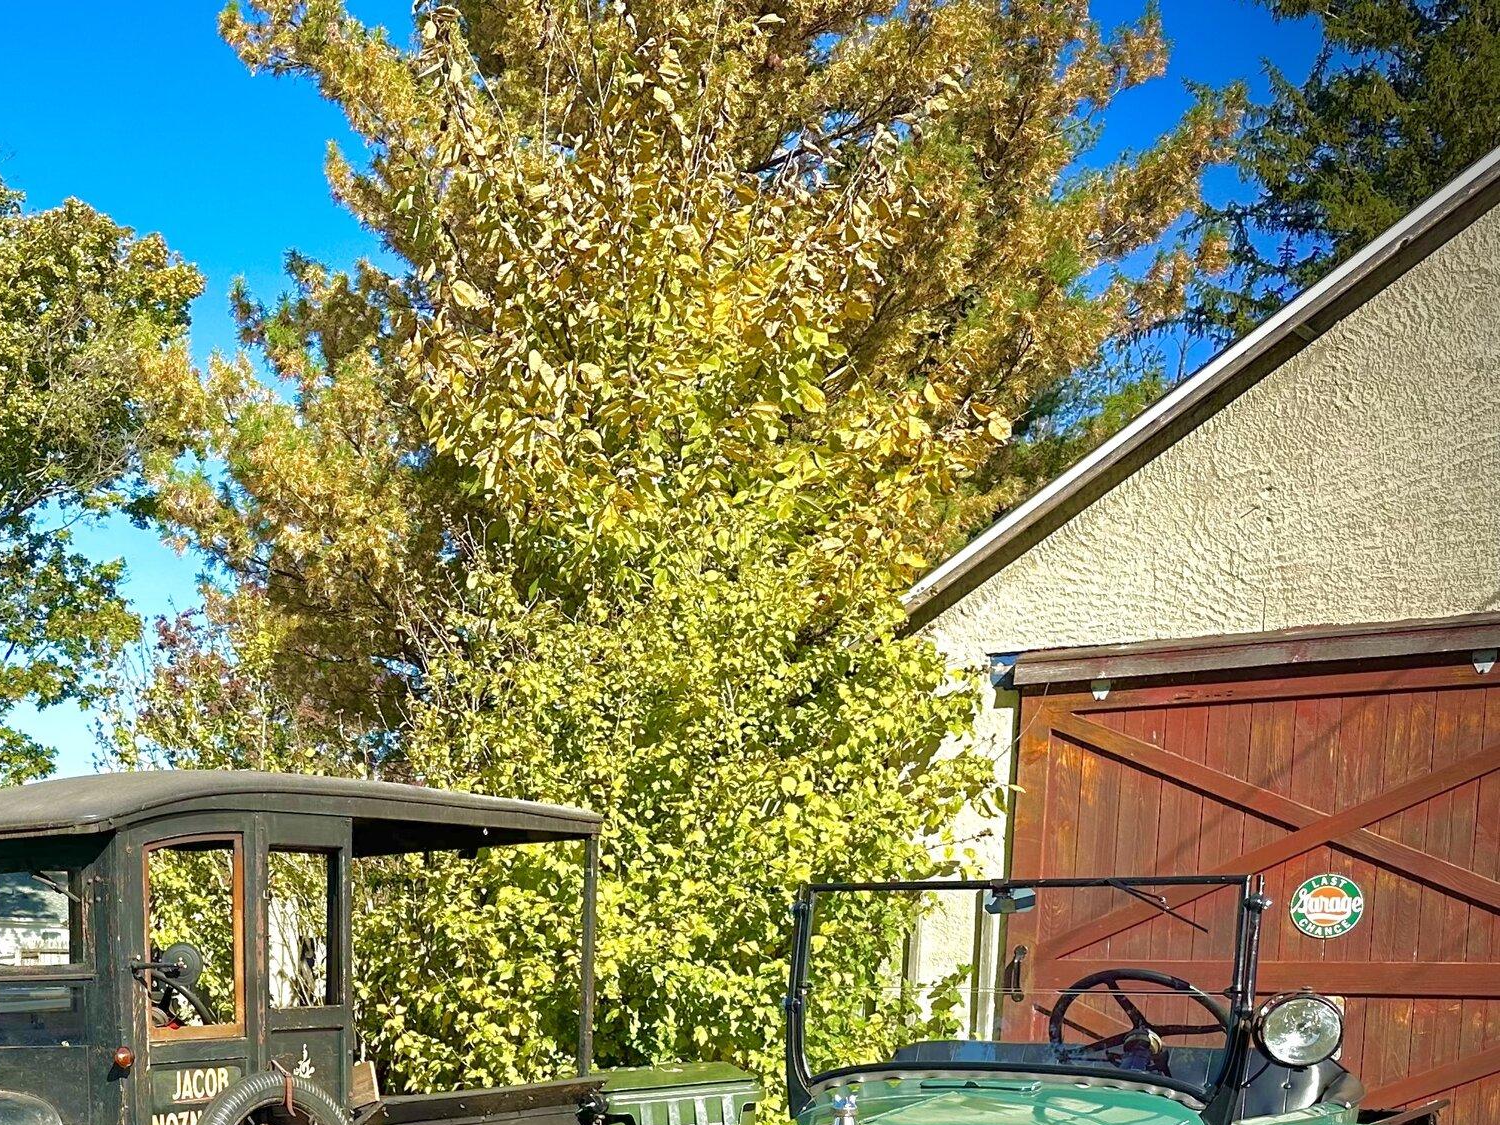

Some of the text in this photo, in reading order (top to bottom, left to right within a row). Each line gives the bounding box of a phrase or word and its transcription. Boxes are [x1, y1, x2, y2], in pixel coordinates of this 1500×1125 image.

[1312, 877, 1348, 888] LAST
[1290, 888, 1363, 920] Garage
[1298, 919, 1351, 936] CHANCE
[172, 1067, 229, 1100] JACOB
